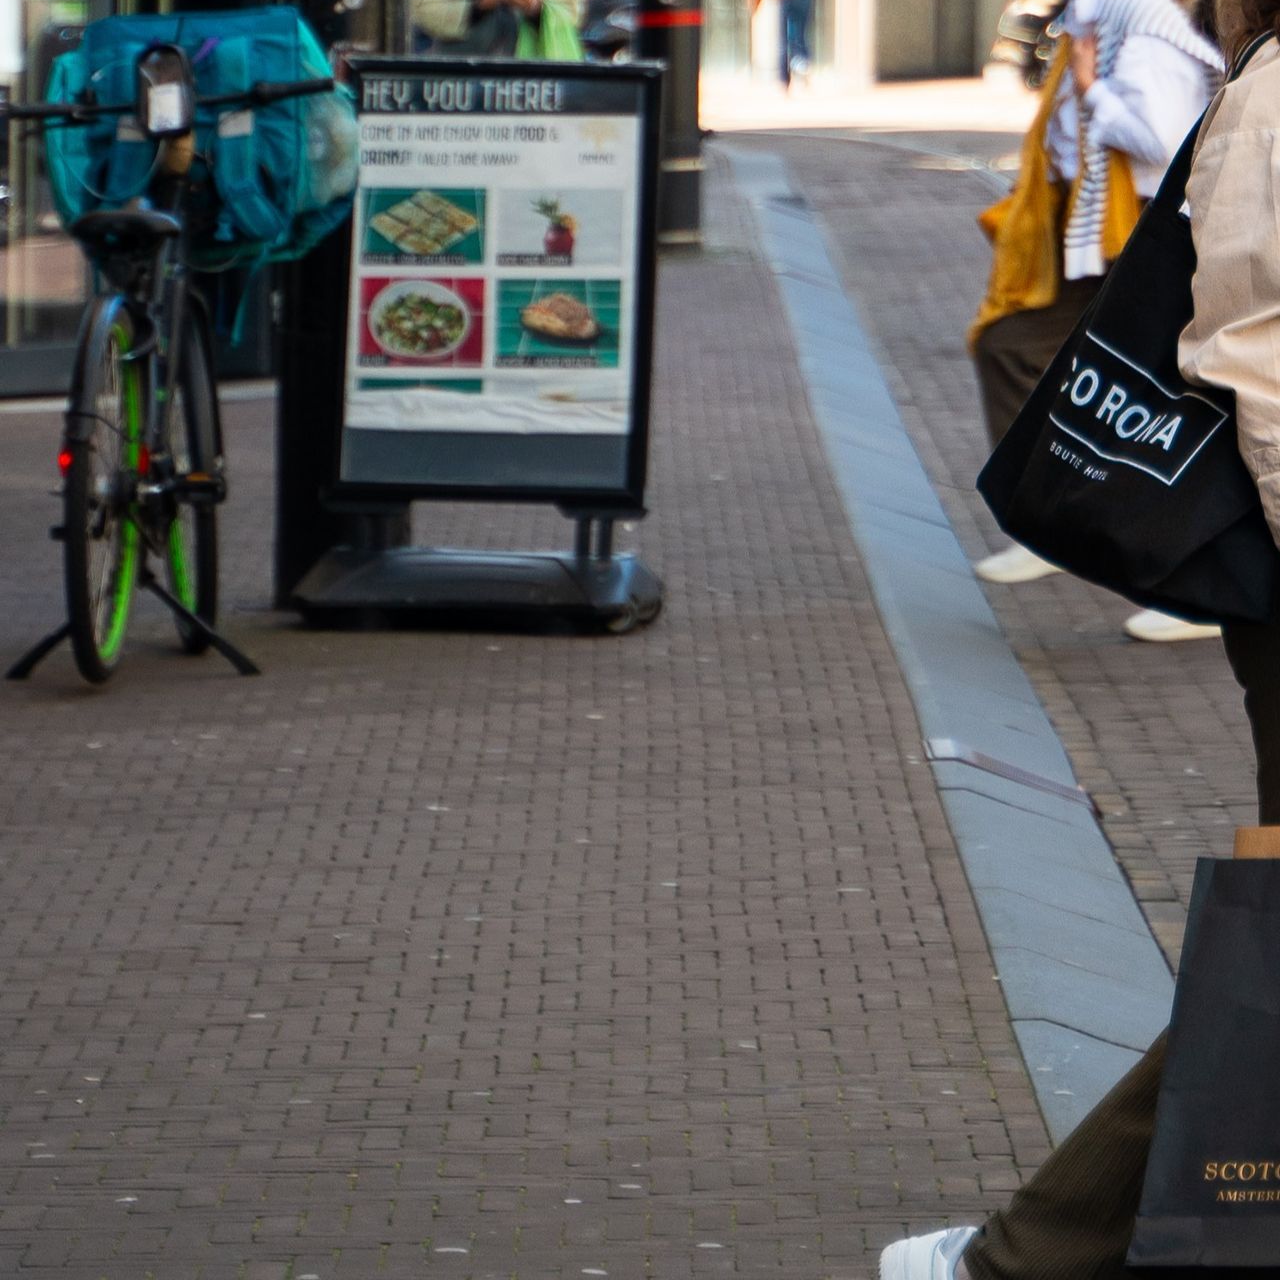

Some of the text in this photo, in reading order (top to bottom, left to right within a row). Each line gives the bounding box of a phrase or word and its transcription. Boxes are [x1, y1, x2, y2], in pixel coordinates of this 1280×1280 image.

[422, 80, 473, 112] YOU
[480, 80, 564, 112] THERE!
[361, 124, 393, 143] COME
[415, 124, 440, 143] AND
[484, 124, 510, 143] OUR
[513, 124, 546, 143] FOOD
